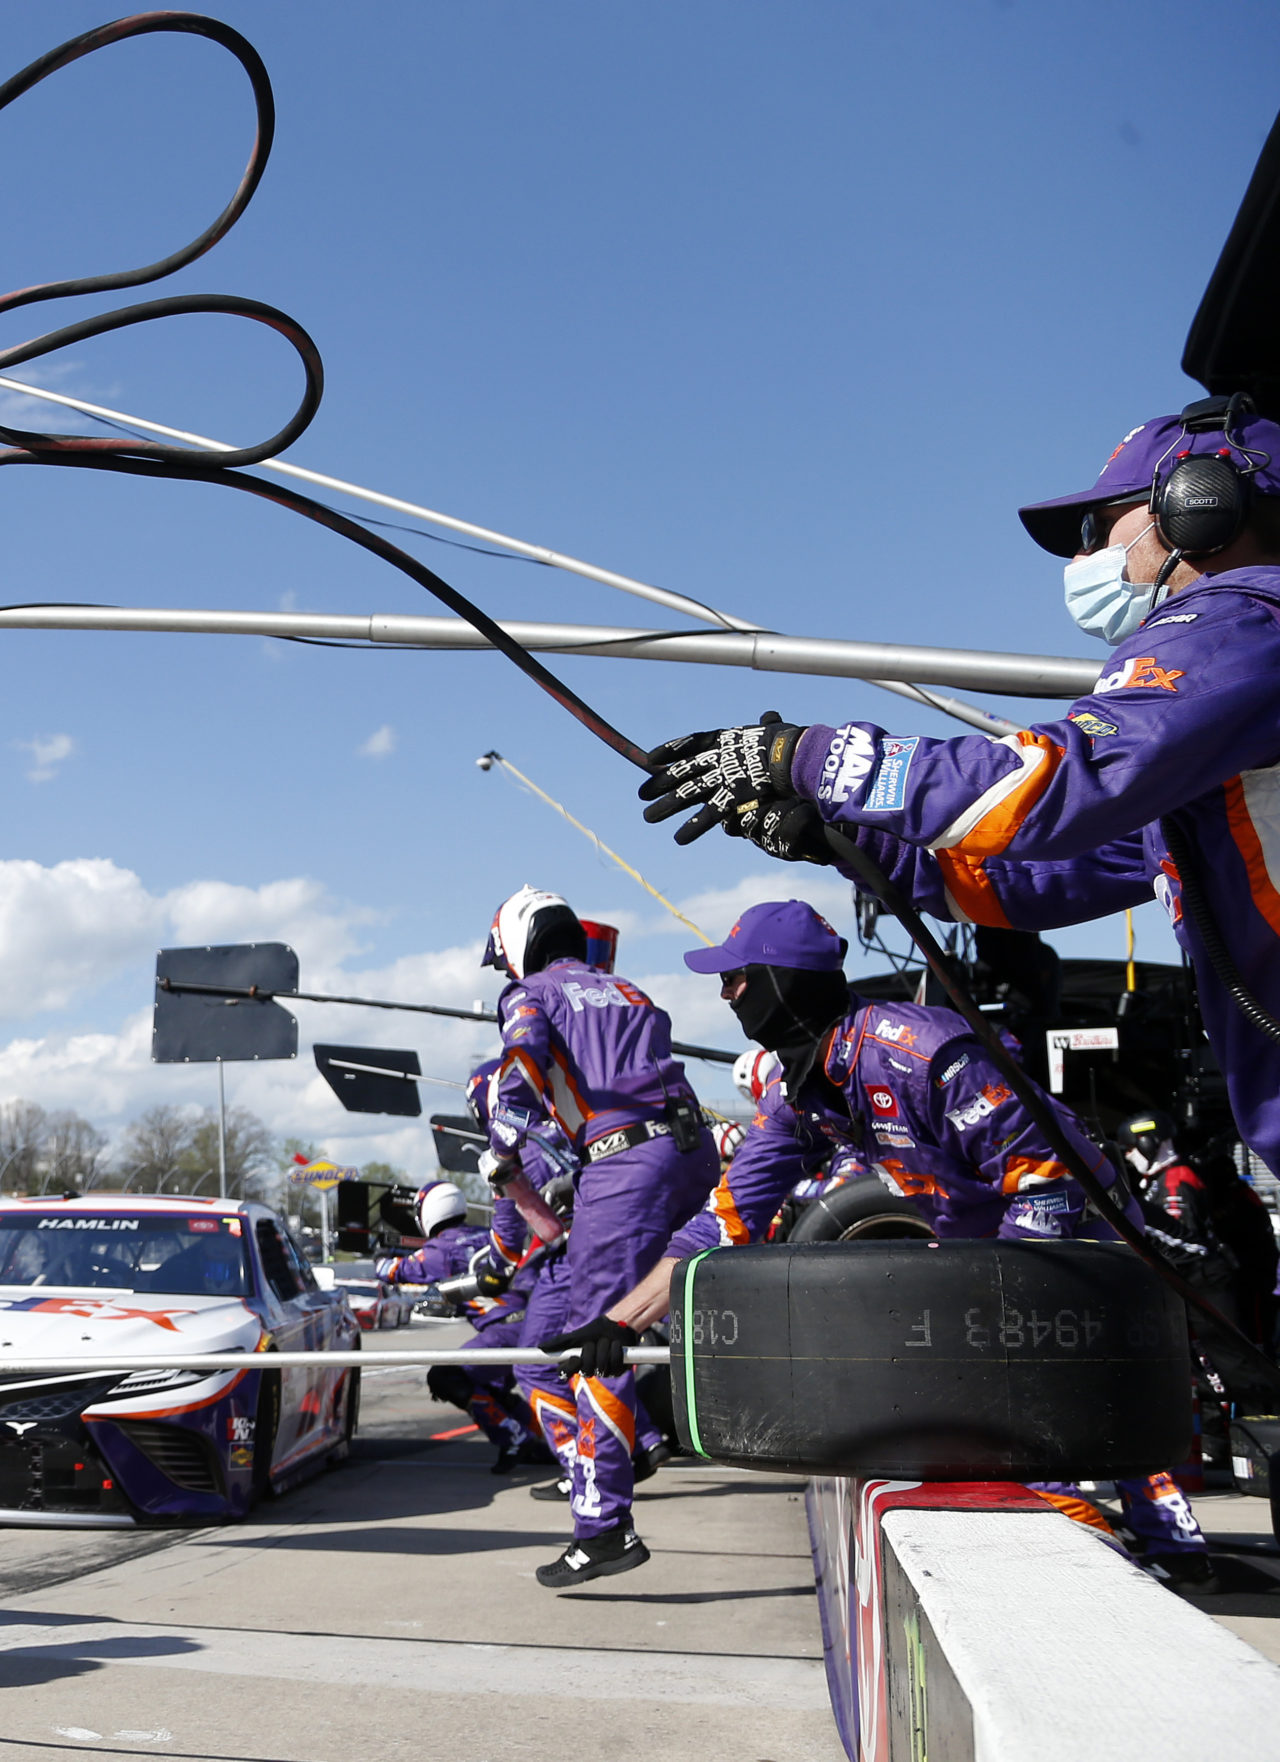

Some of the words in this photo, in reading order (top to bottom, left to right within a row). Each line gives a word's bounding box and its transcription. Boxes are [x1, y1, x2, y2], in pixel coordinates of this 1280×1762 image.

[742, 726, 771, 790] Mechanix
[818, 725, 851, 801] TOOLS
[886, 758, 903, 805] SHERWIN
[874, 759, 892, 809] WILLIAMS
[561, 982, 648, 1013] FedE
[875, 1019, 918, 1047] FedEx
[945, 1083, 1012, 1131] FedEx
[291, 1167, 358, 1184] SUNOCO
[38, 1219, 139, 1230] HAMLIN
[905, 1309, 931, 1347] F
[572, 1416, 602, 1518] FedEx
